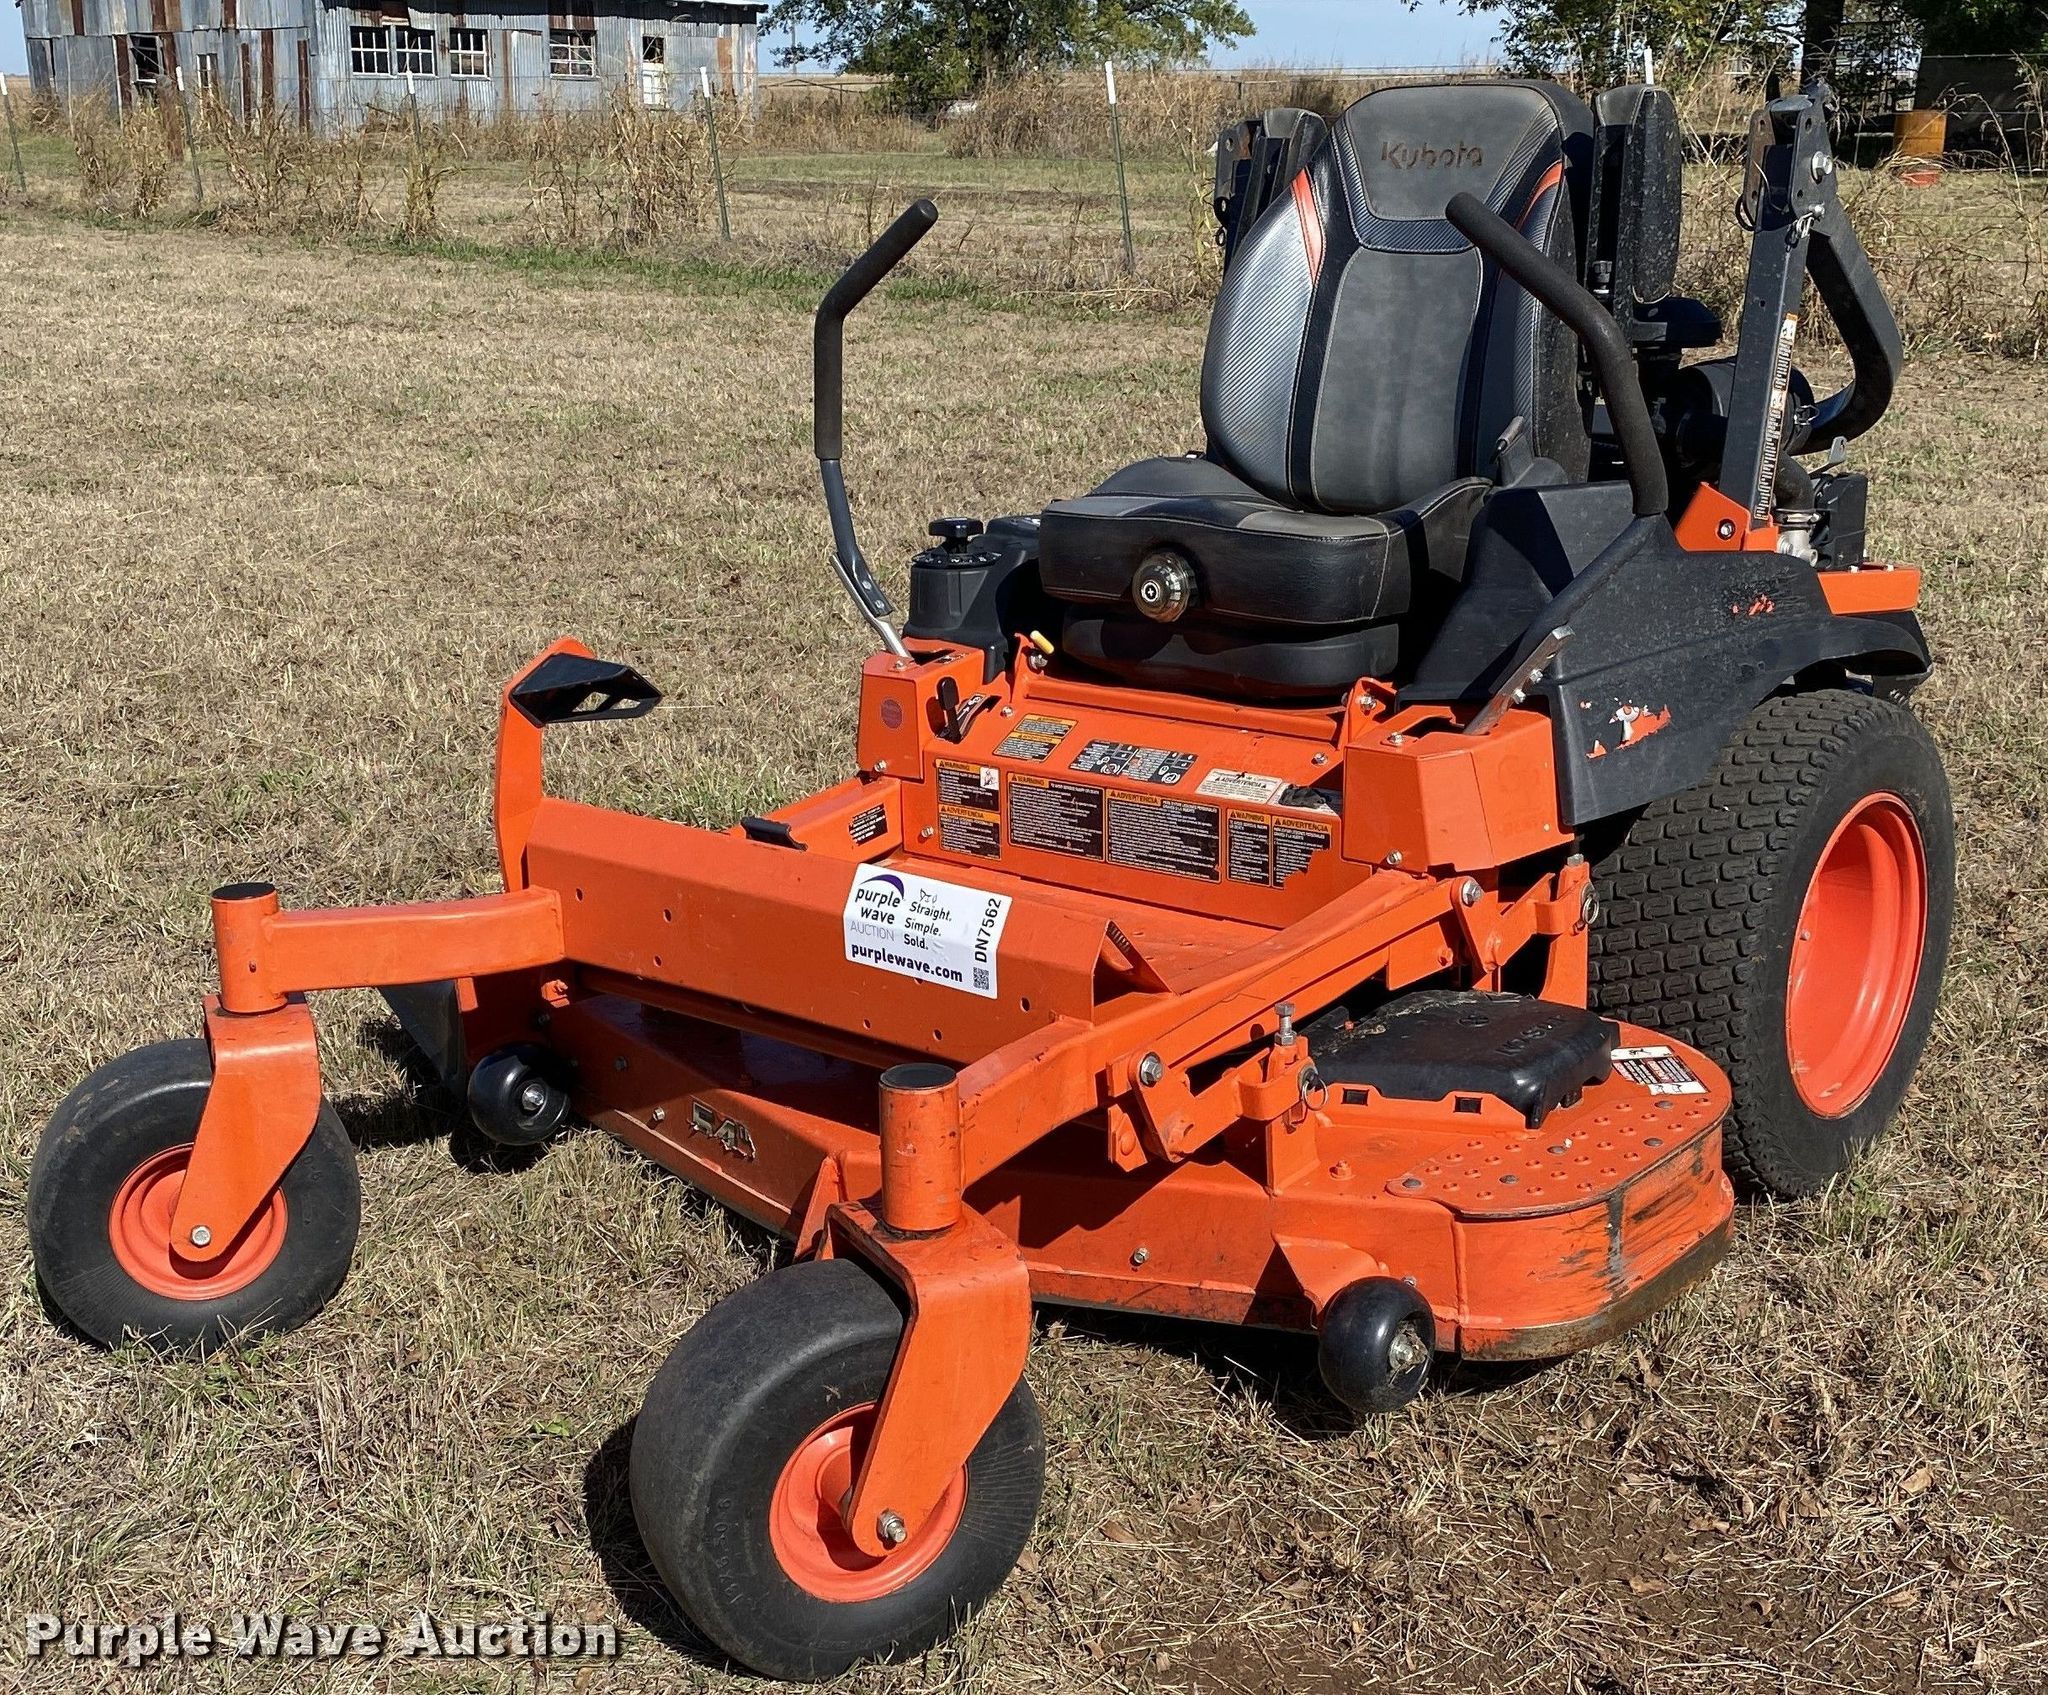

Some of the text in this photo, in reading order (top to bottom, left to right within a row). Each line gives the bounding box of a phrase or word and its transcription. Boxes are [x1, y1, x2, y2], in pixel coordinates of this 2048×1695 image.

[1380, 140, 1485, 170] Kubota
[1017, 776, 1045, 786] WARNING
[1220, 777, 1262, 788] ADVERTENCIA
[1116, 793, 1158, 804] ADVERTENCIA
[1236, 811, 1265, 822] WARNING
[1282, 819, 1329, 832] ADVERTENCIA
[855, 888, 901, 908] purple
[860, 906, 895, 925] wave
[909, 901, 952, 922] Straight.
[850, 920, 895, 941] AUCTION
[904, 917, 942, 937] Simple.
[974, 898, 1001, 963] DN7562
[903, 933, 929, 951] Sold.
[851, 943, 963, 982] purplewave.com
